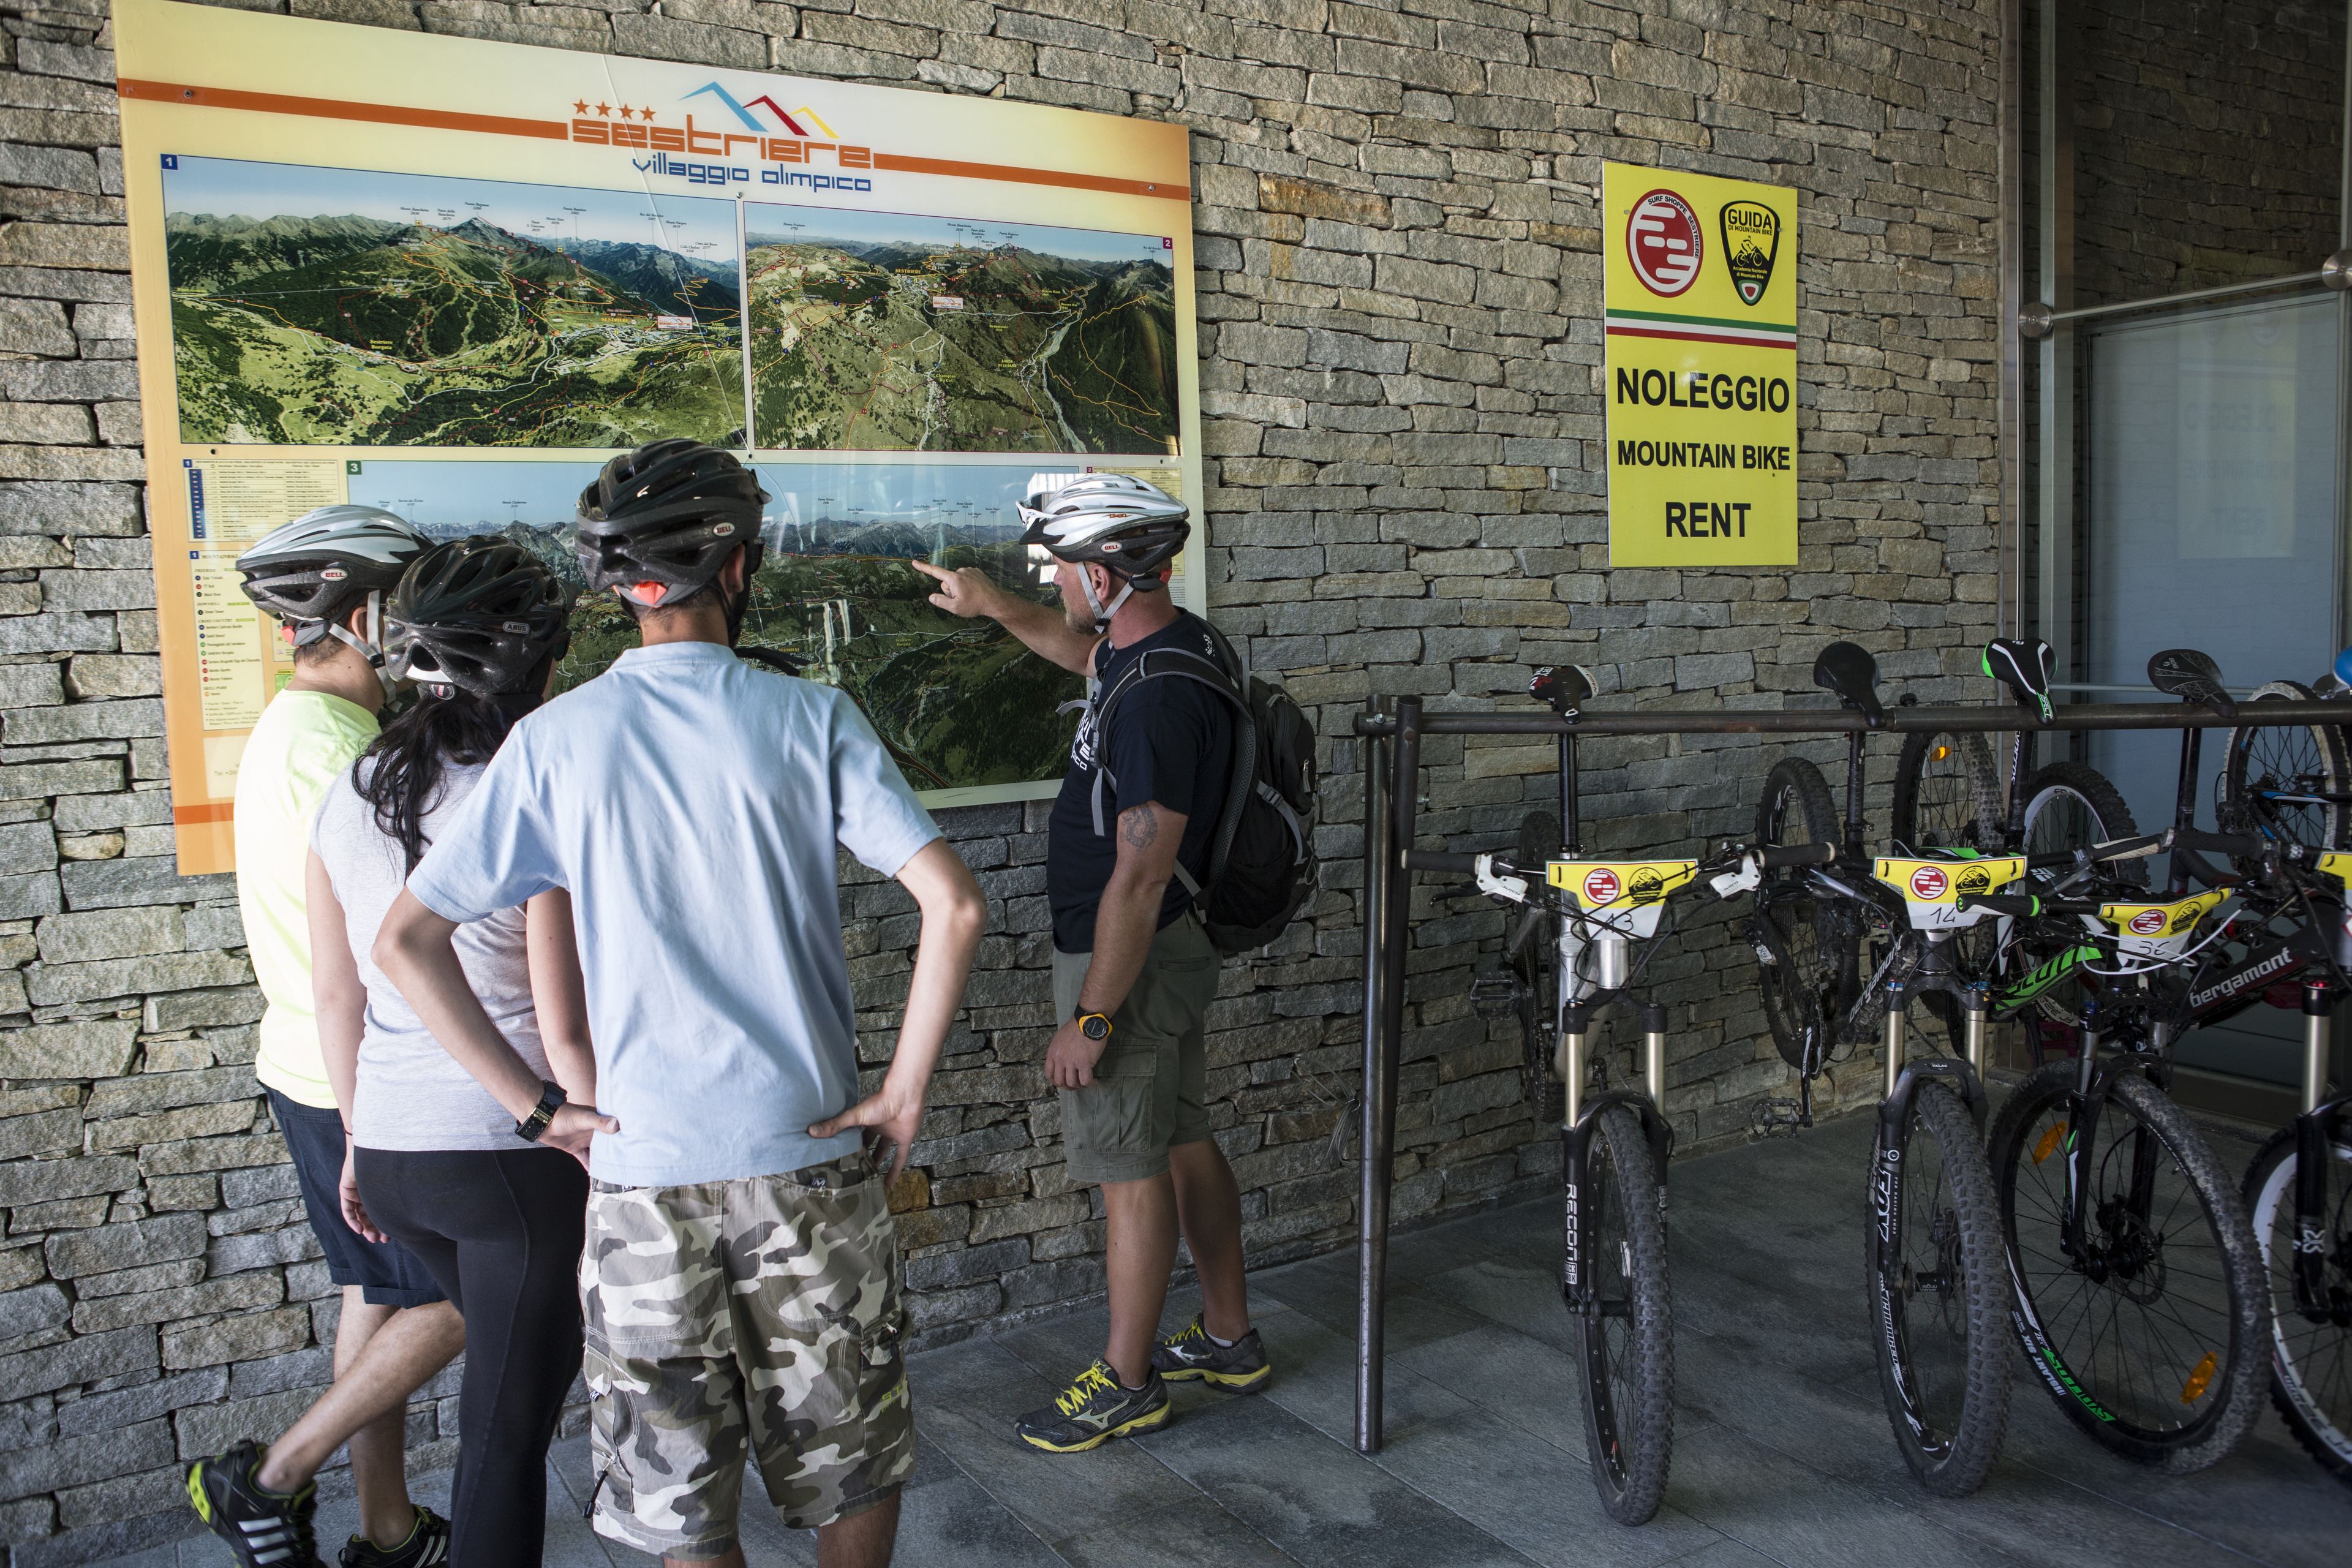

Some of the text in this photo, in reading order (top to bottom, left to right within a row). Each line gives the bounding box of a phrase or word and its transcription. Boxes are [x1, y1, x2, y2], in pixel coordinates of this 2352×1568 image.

[572, 114, 871, 169] sestriere
[165, 157, 174, 167] 1
[632, 152, 872, 192] villaggio olimpico
[1648, 195, 1700, 260] SURF SHOPPE SESTRIERE
[1728, 208, 1773, 230] GUIDA
[1734, 225, 1762, 235] MOUNTAIN
[1617, 368, 1790, 413] NOLEGGIO
[350, 463, 358, 472] 3
[1618, 440, 1790, 470] MOUNTAIN BIKE
[1665, 502, 1752, 538] RENT
[1931, 907, 1956, 924] 14
[2189, 946, 2293, 1008] bergamont
